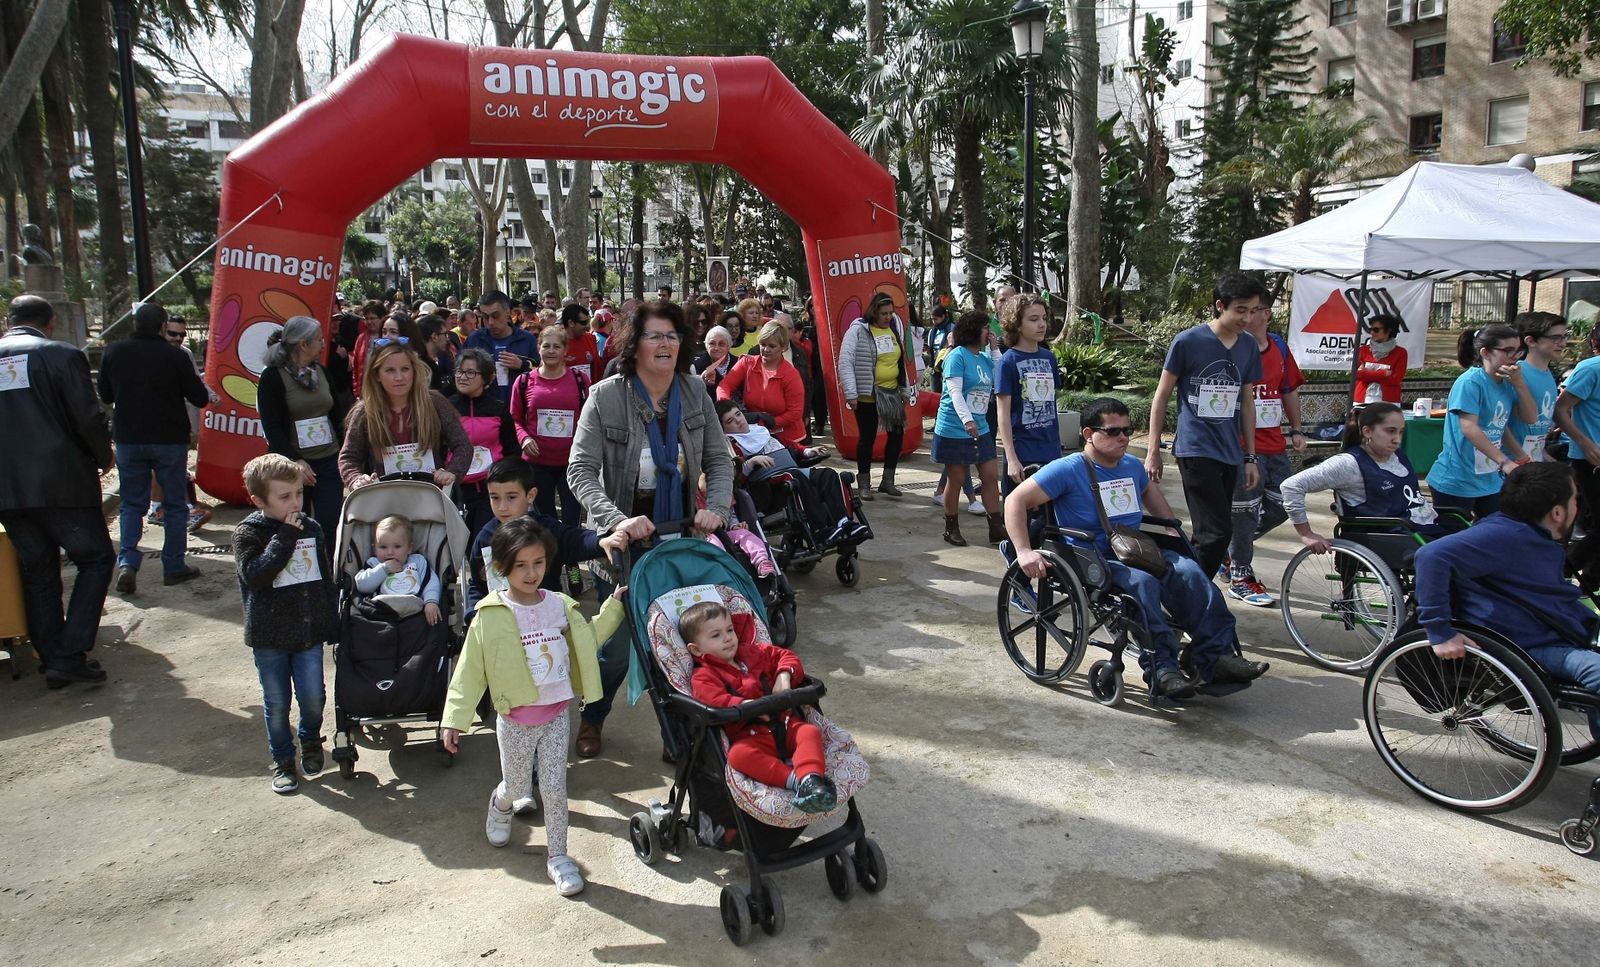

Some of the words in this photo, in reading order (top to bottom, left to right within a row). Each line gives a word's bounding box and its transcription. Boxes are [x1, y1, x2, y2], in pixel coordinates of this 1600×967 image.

[483, 59, 706, 116] animagic
[485, 102, 520, 119] con
[531, 100, 548, 120] el
[559, 103, 638, 127] deporte
[220, 245, 333, 285] animagic
